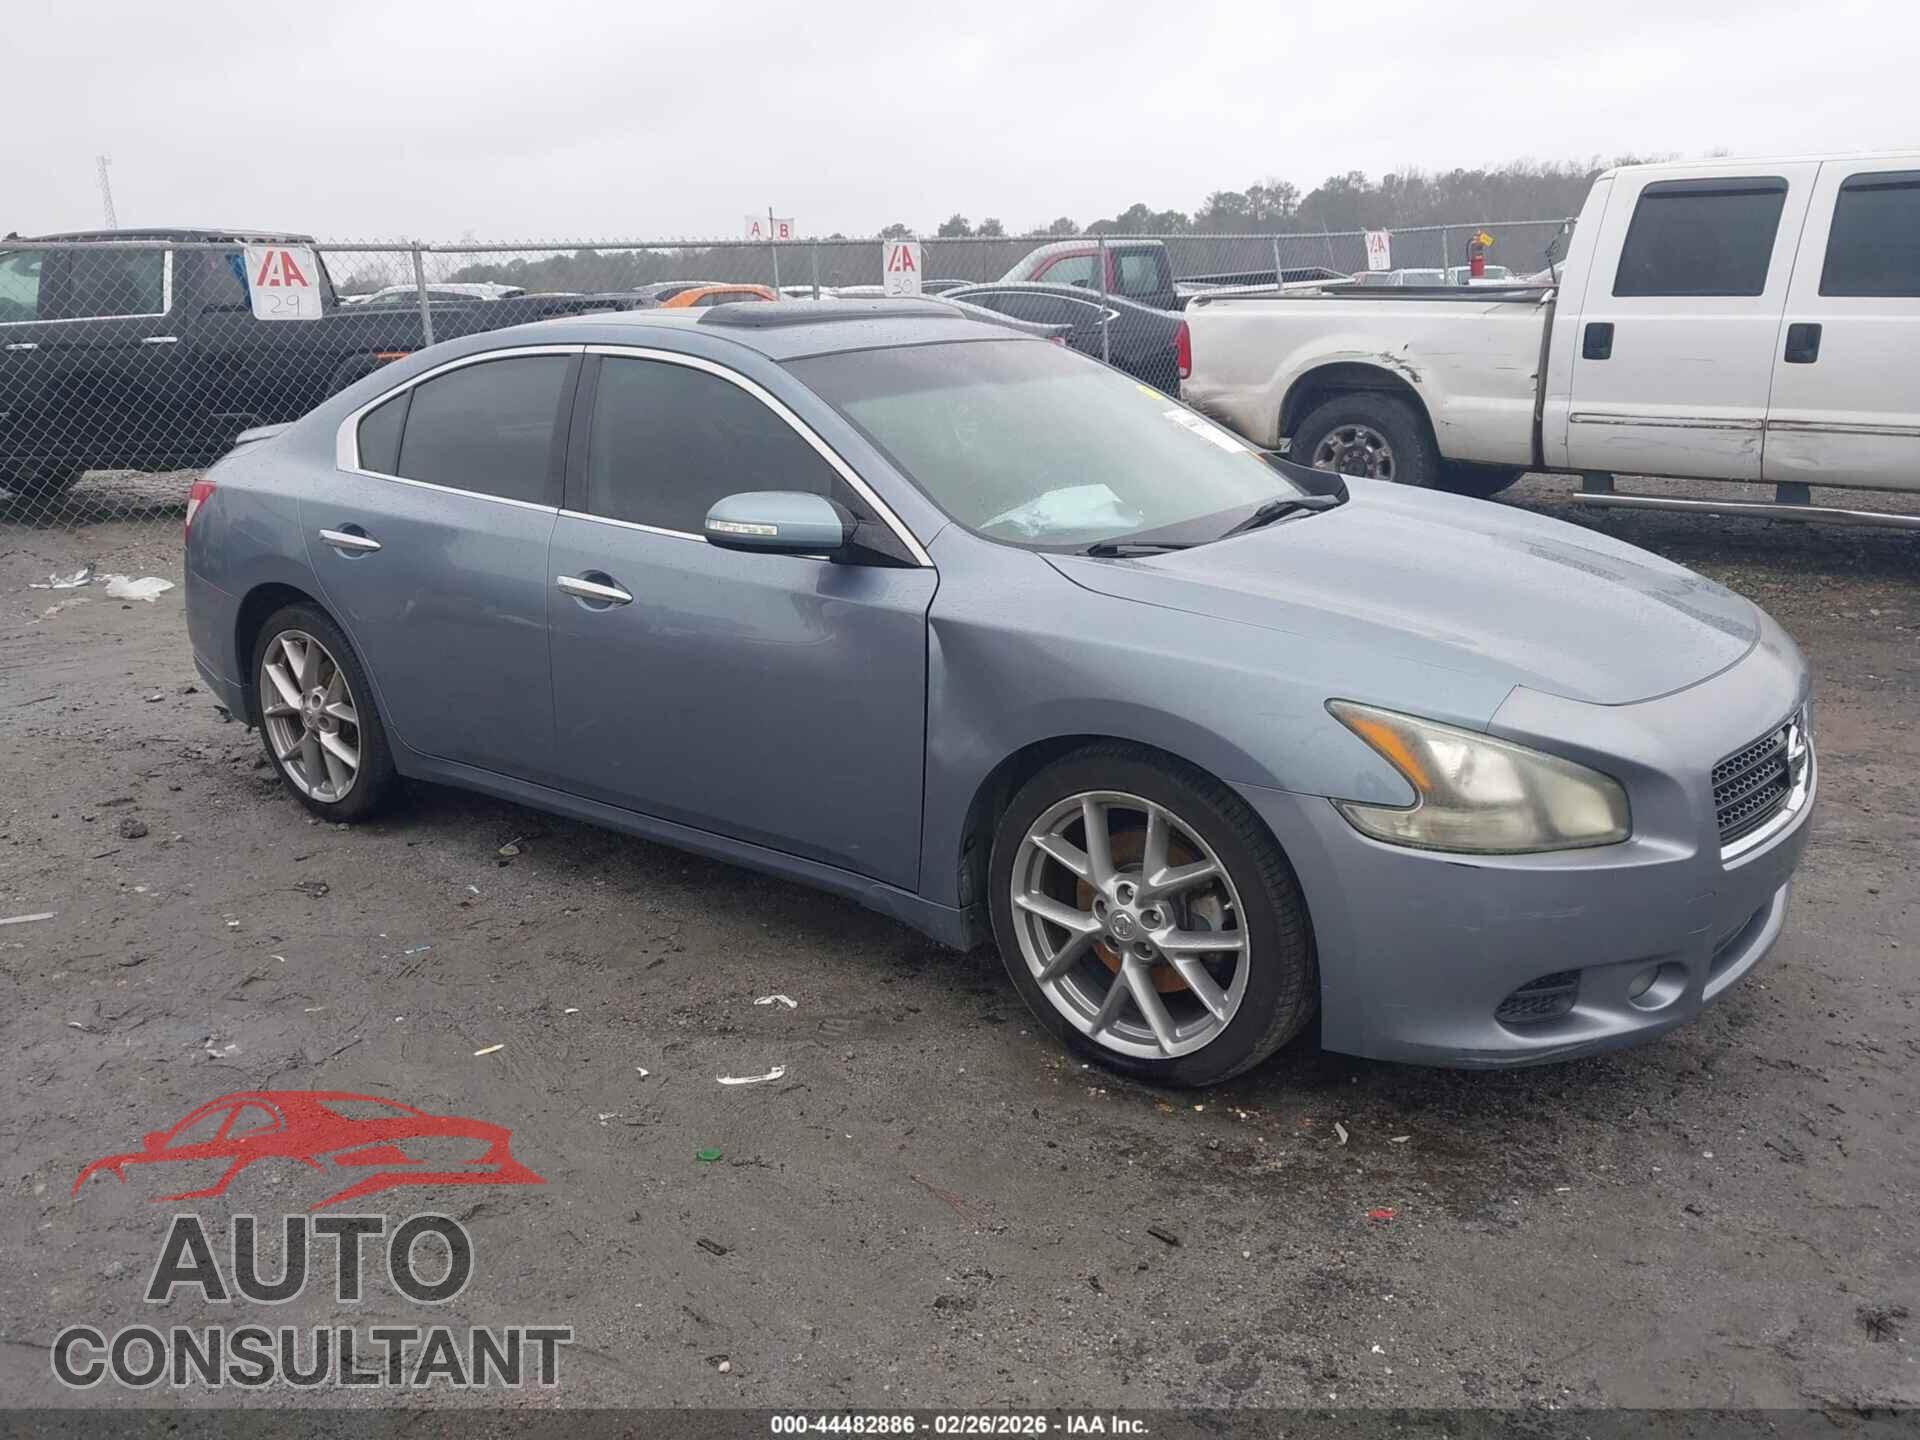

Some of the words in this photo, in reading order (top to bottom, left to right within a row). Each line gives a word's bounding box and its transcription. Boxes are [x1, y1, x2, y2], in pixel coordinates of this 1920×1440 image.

[751, 221, 761, 236] A
[779, 223, 789, 238] B
[262, 294, 300, 317] 29
